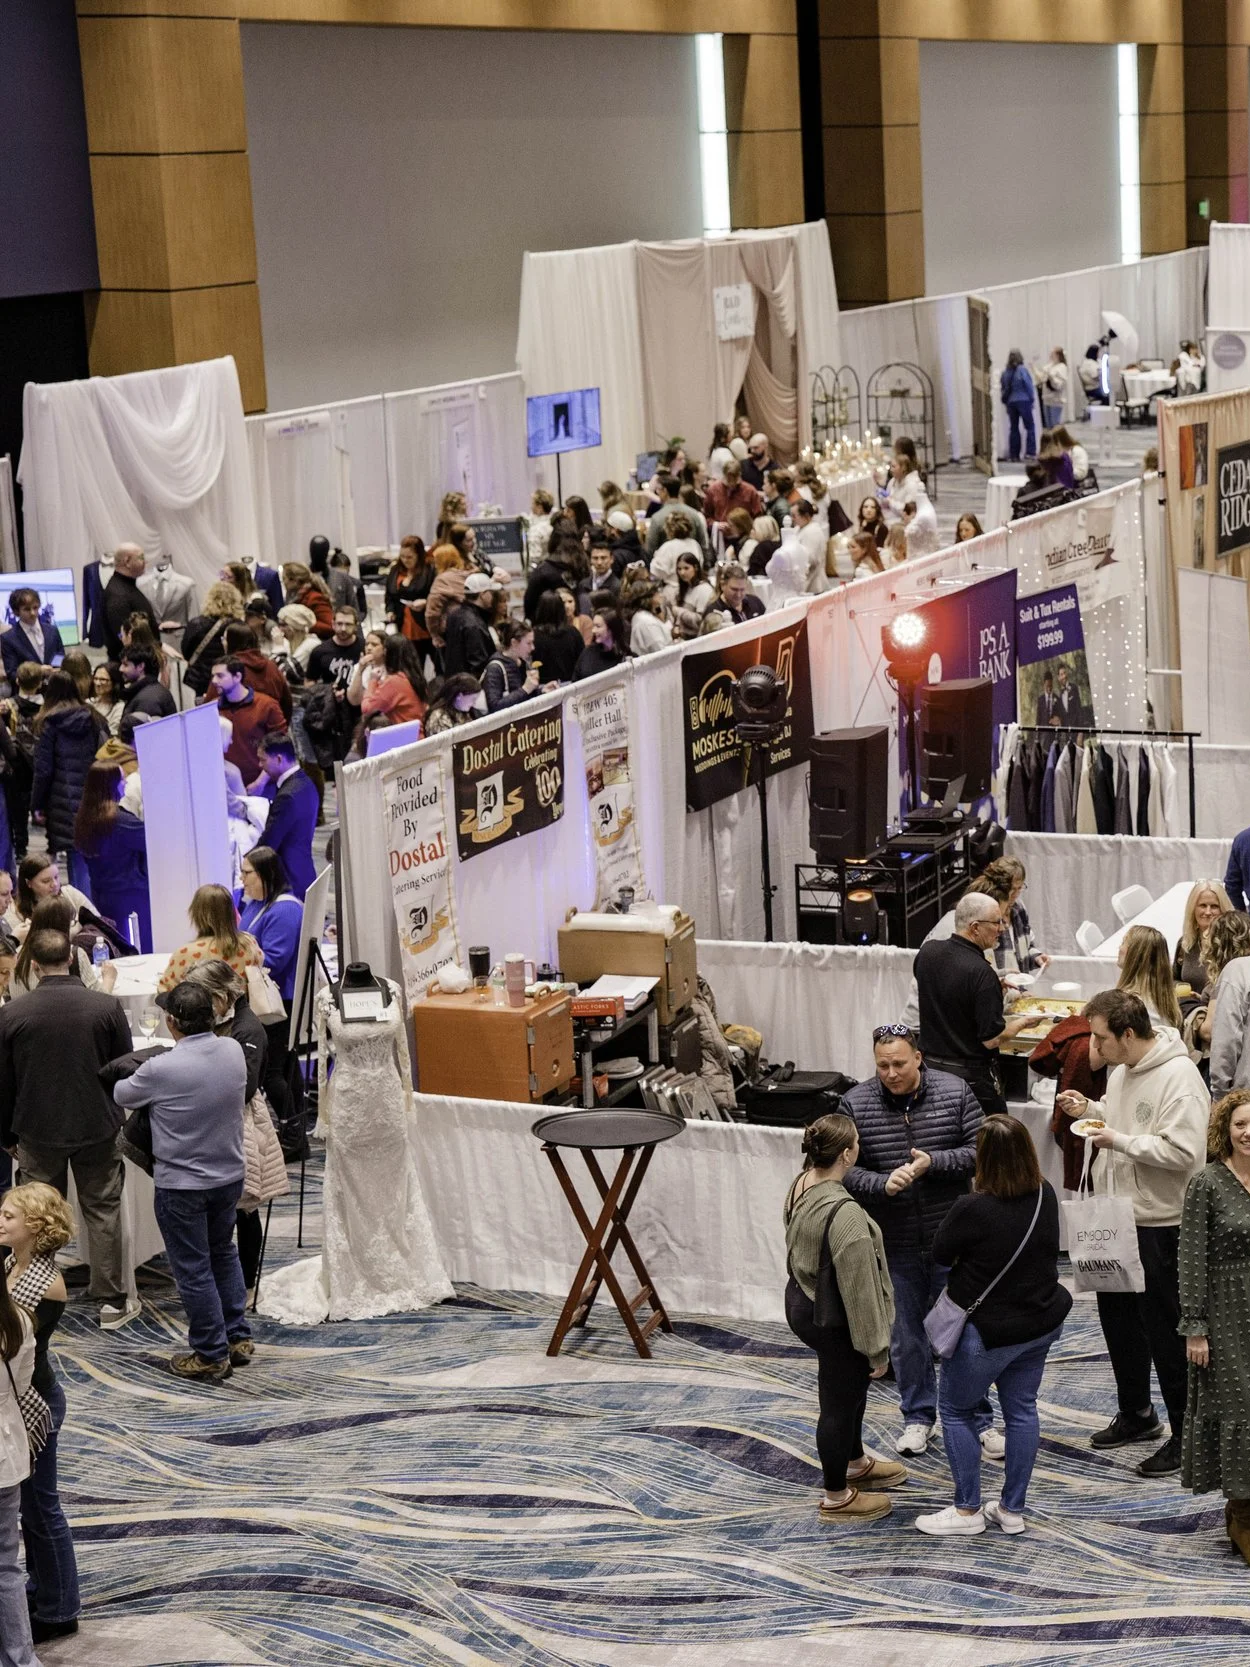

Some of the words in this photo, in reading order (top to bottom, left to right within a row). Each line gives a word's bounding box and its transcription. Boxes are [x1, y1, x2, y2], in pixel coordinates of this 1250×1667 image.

[1020, 606, 1034, 623] Suit
[1034, 605, 1040, 620] &
[1040, 603, 1052, 617] Tux
[1052, 595, 1076, 614] Rentals
[979, 649, 1012, 684] BANK
[604, 709, 622, 725] Hall
[462, 732, 504, 776] Dostal
[507, 718, 562, 758] Catering
[523, 748, 558, 772] Celebrating
[770, 748, 791, 765] Services
[396, 768, 423, 795] Food
[536, 765, 562, 804] 100
[391, 786, 438, 823] Provided
[403, 818, 418, 840] By
[389, 830, 446, 877] Dostal
[1077, 1229, 1118, 1242] EMBODY
[1077, 1259, 1123, 1273] BAUMAN'S
